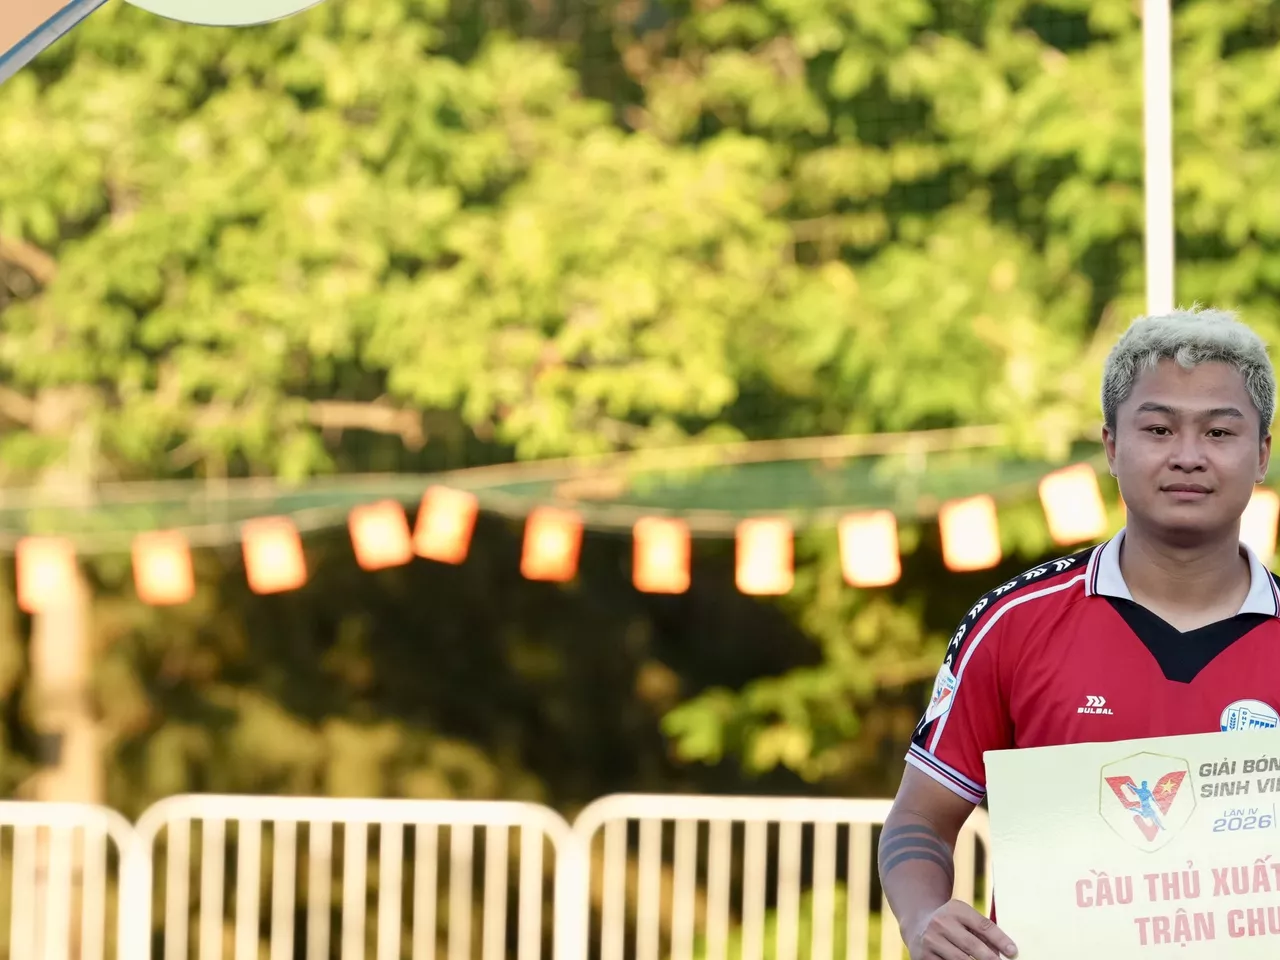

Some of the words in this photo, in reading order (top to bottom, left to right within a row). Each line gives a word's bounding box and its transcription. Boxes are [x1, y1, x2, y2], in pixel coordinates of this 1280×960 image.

[1199, 758, 1236, 777] GIẢI
[1200, 780, 1250, 799] SINH
[1248, 807, 1258, 815] IV
[1212, 814, 1272, 833] 2026
[1075, 868, 1134, 909] CẦU
[1143, 860, 1201, 903] THỦ
[1133, 907, 1216, 948] TRẬN
